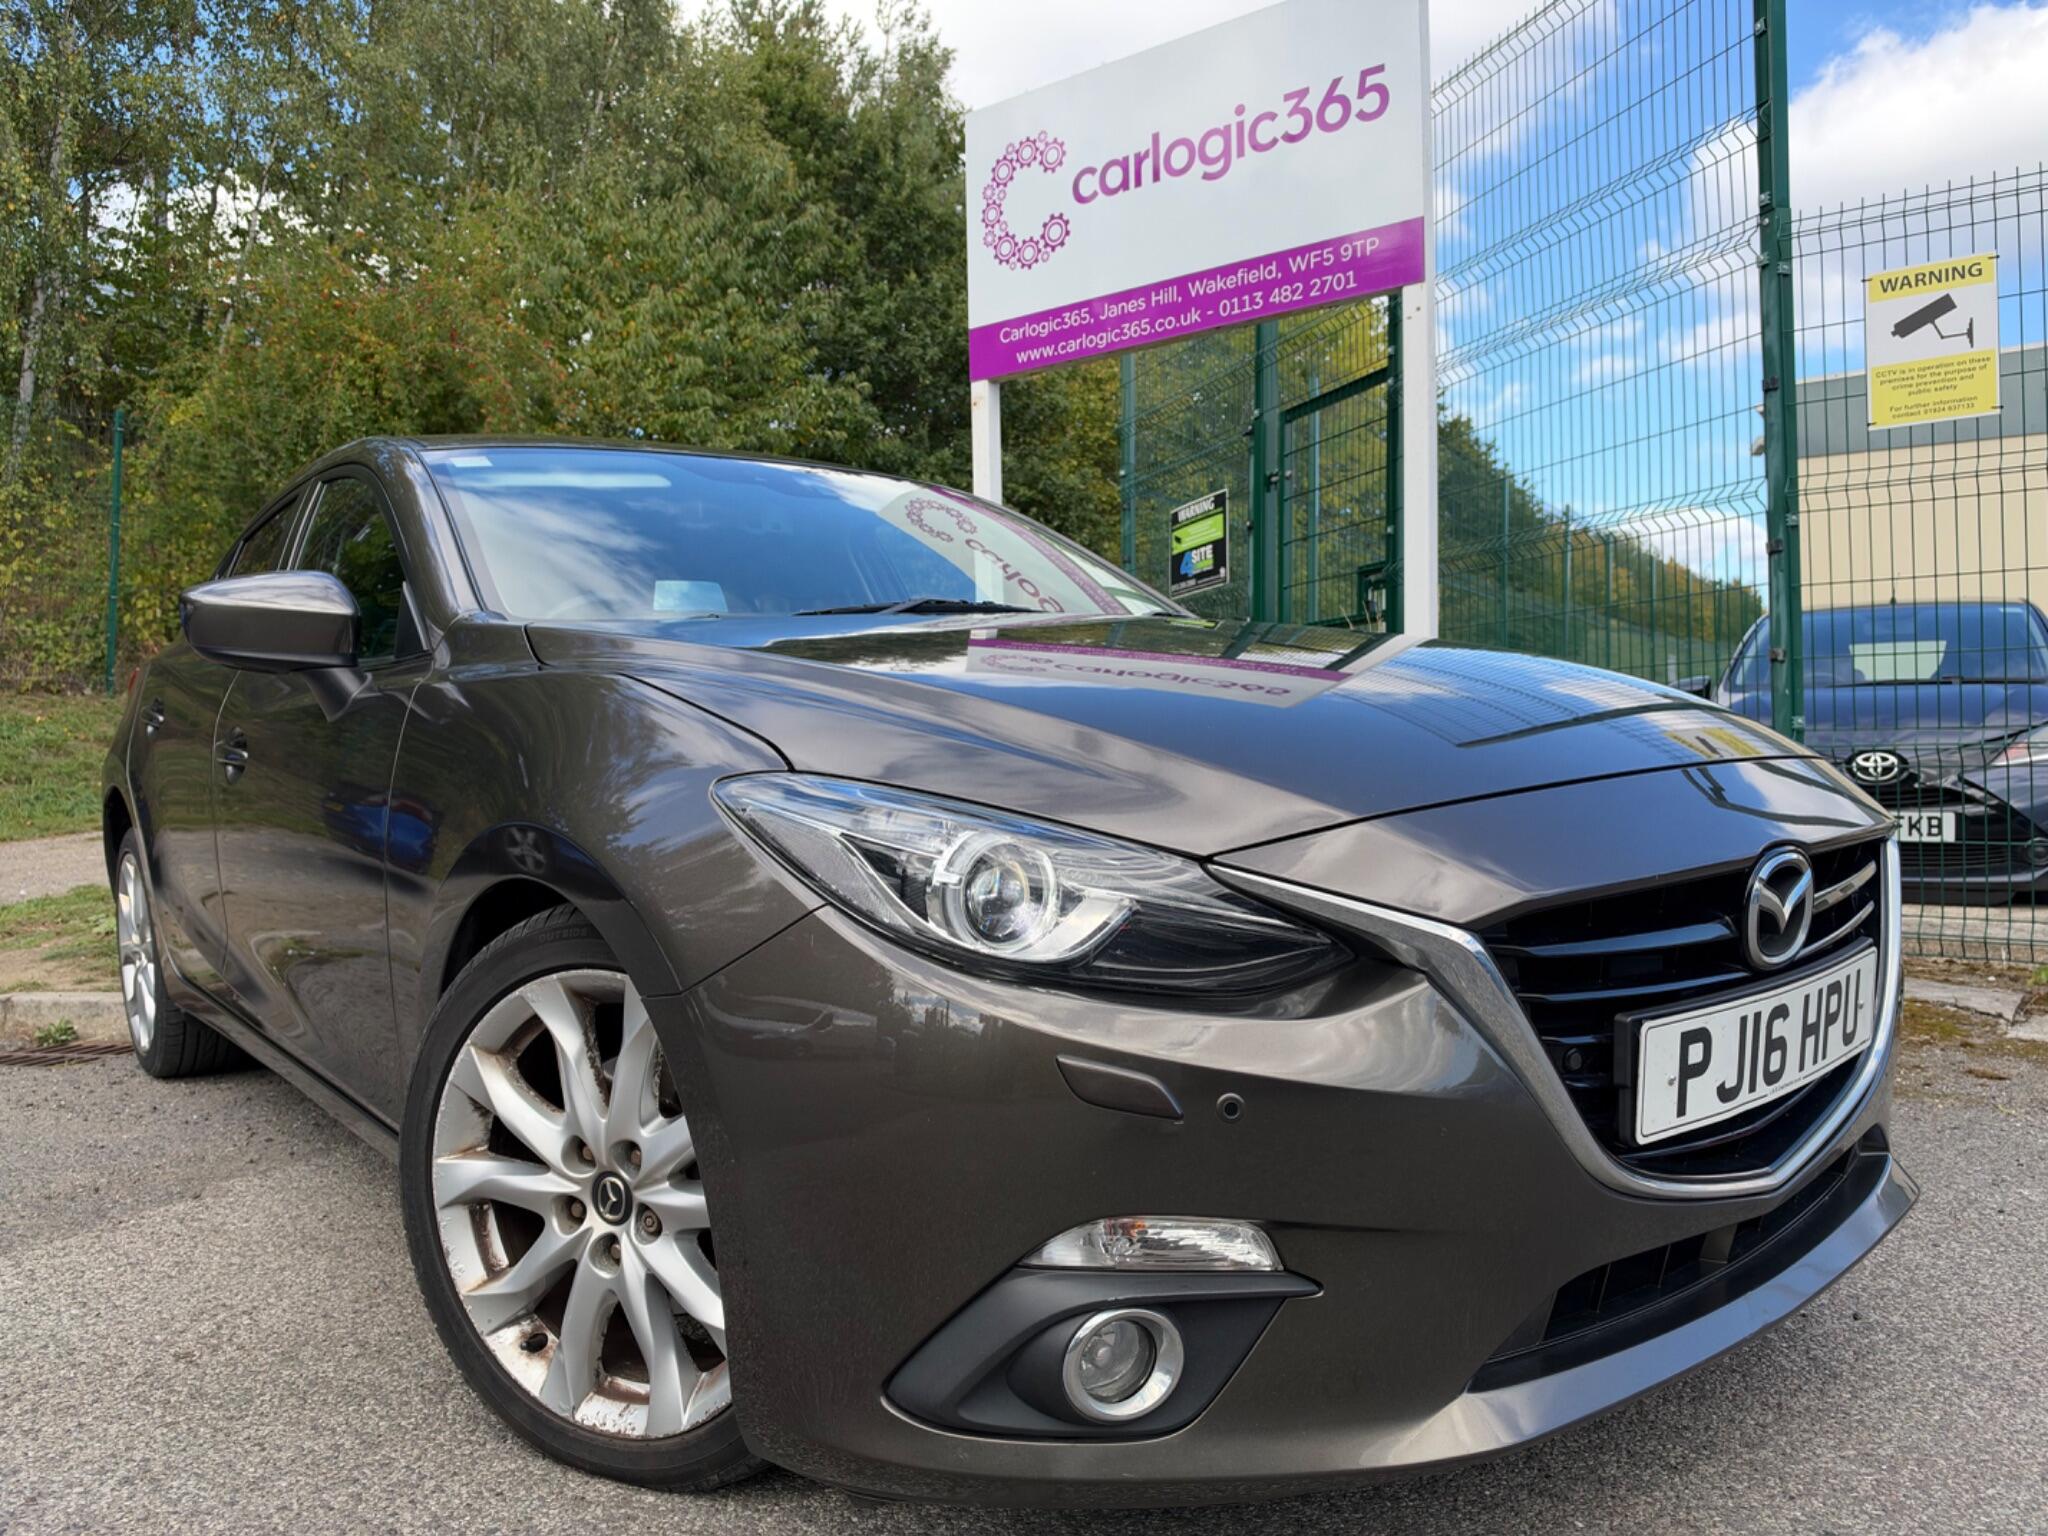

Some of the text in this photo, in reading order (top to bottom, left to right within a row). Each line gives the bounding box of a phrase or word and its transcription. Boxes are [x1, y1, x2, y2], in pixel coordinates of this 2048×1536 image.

[1072, 63, 1390, 205] carlogic365
[1000, 237, 1379, 343] Carlogic365, Janes Hill, Wakefield, WF5 9TP
[1880, 262, 1983, 293] WARNING
[1016, 308, 1201, 363] www.carlogic365.co.uk
[1219, 292, 1264, 317] 0113
[1269, 283, 1303, 304] 482
[1310, 271, 1357, 297] 2701
[1876, 369, 1897, 378] CCTV
[1917, 361, 1954, 373] operation
[1969, 356, 1991, 364] these
[1929, 370, 1941, 378] the
[1944, 366, 1976, 377] purpose
[1892, 383, 1914, 391] crime
[1915, 377, 1957, 388] prevention
[1908, 383, 1958, 396] public safety
[1904, 402, 1930, 410] further
[1932, 396, 1978, 406] information
[1178, 496, 1215, 522] WARNING
[1676, 968, 1861, 1119] PJ16 HPU
